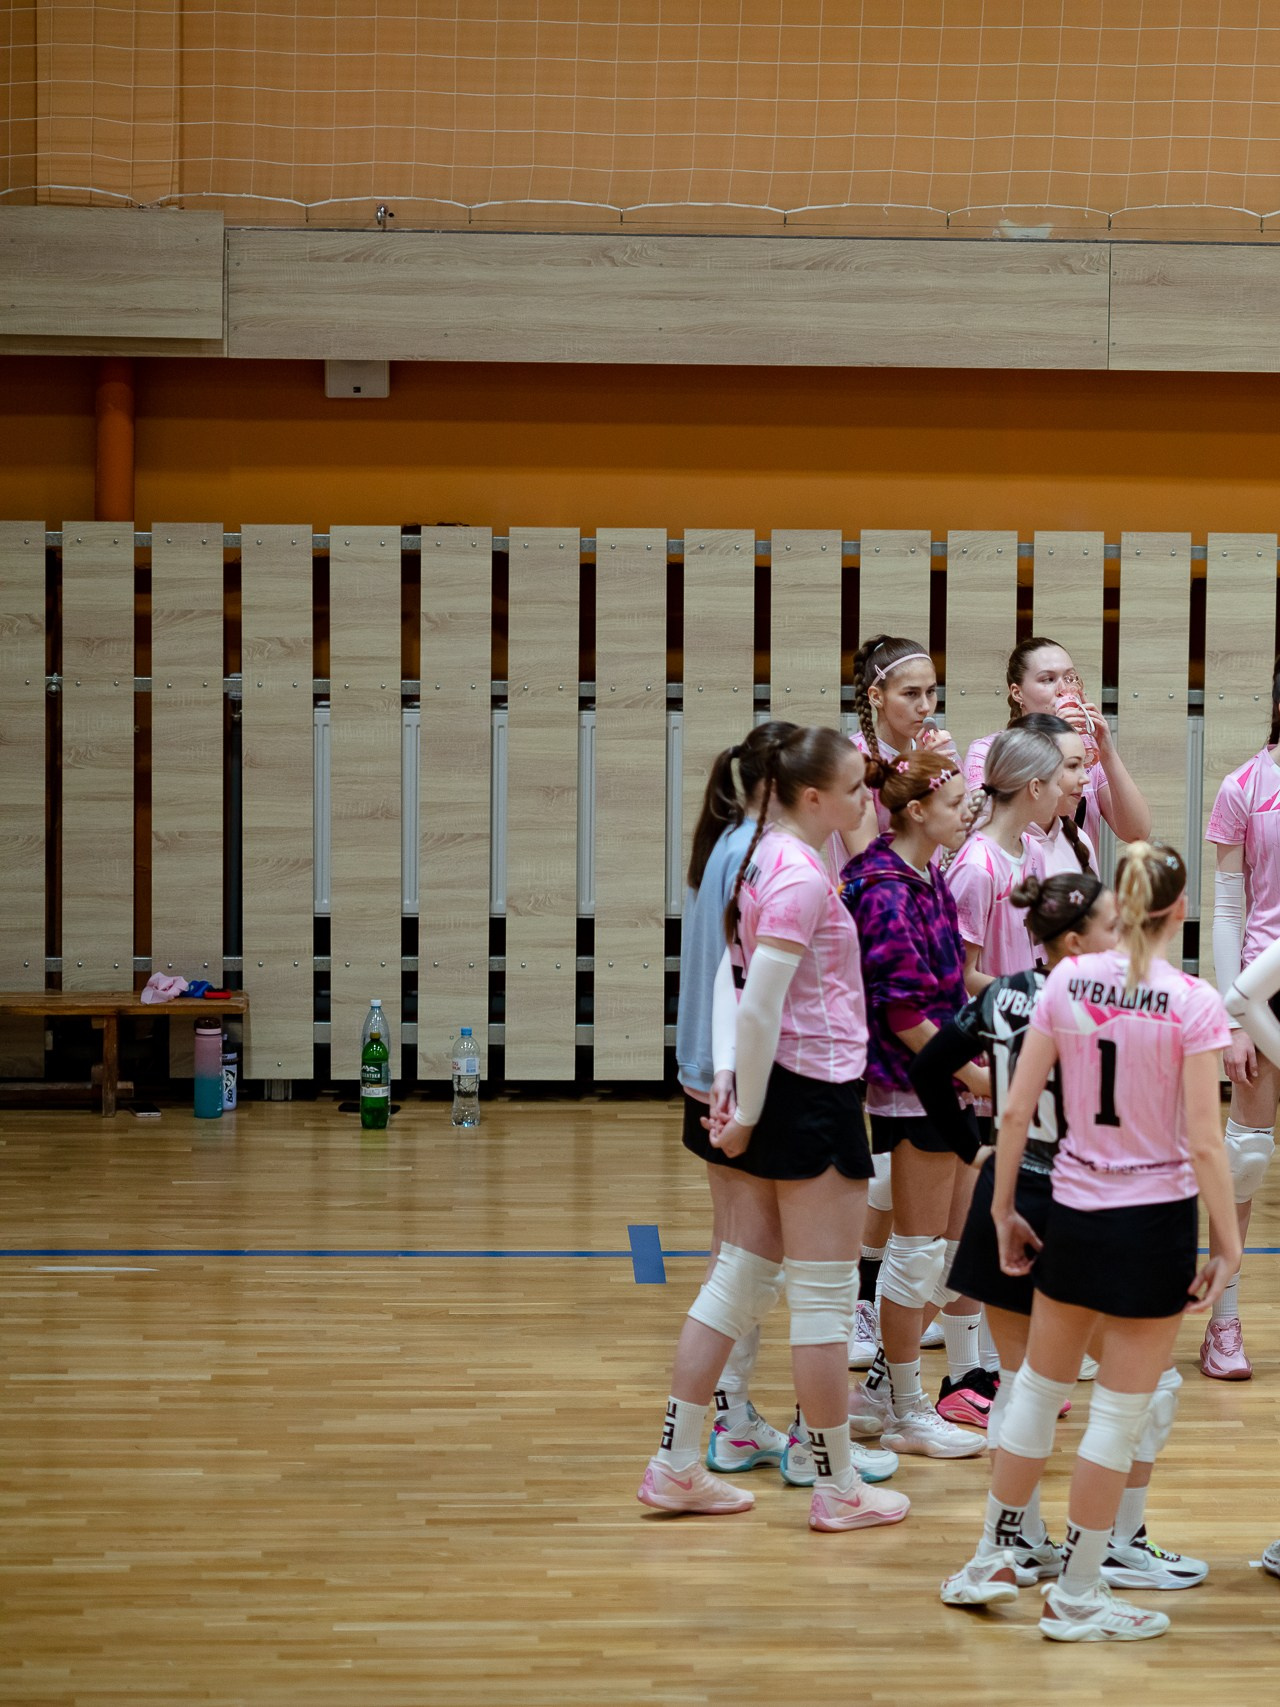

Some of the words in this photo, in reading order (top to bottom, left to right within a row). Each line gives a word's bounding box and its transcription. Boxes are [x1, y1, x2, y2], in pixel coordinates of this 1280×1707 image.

[996, 987, 1037, 1018] ЧУВА
[1068, 978, 1169, 1014] ЧУВАШИЯ
[1094, 1038, 1121, 1128] 1
